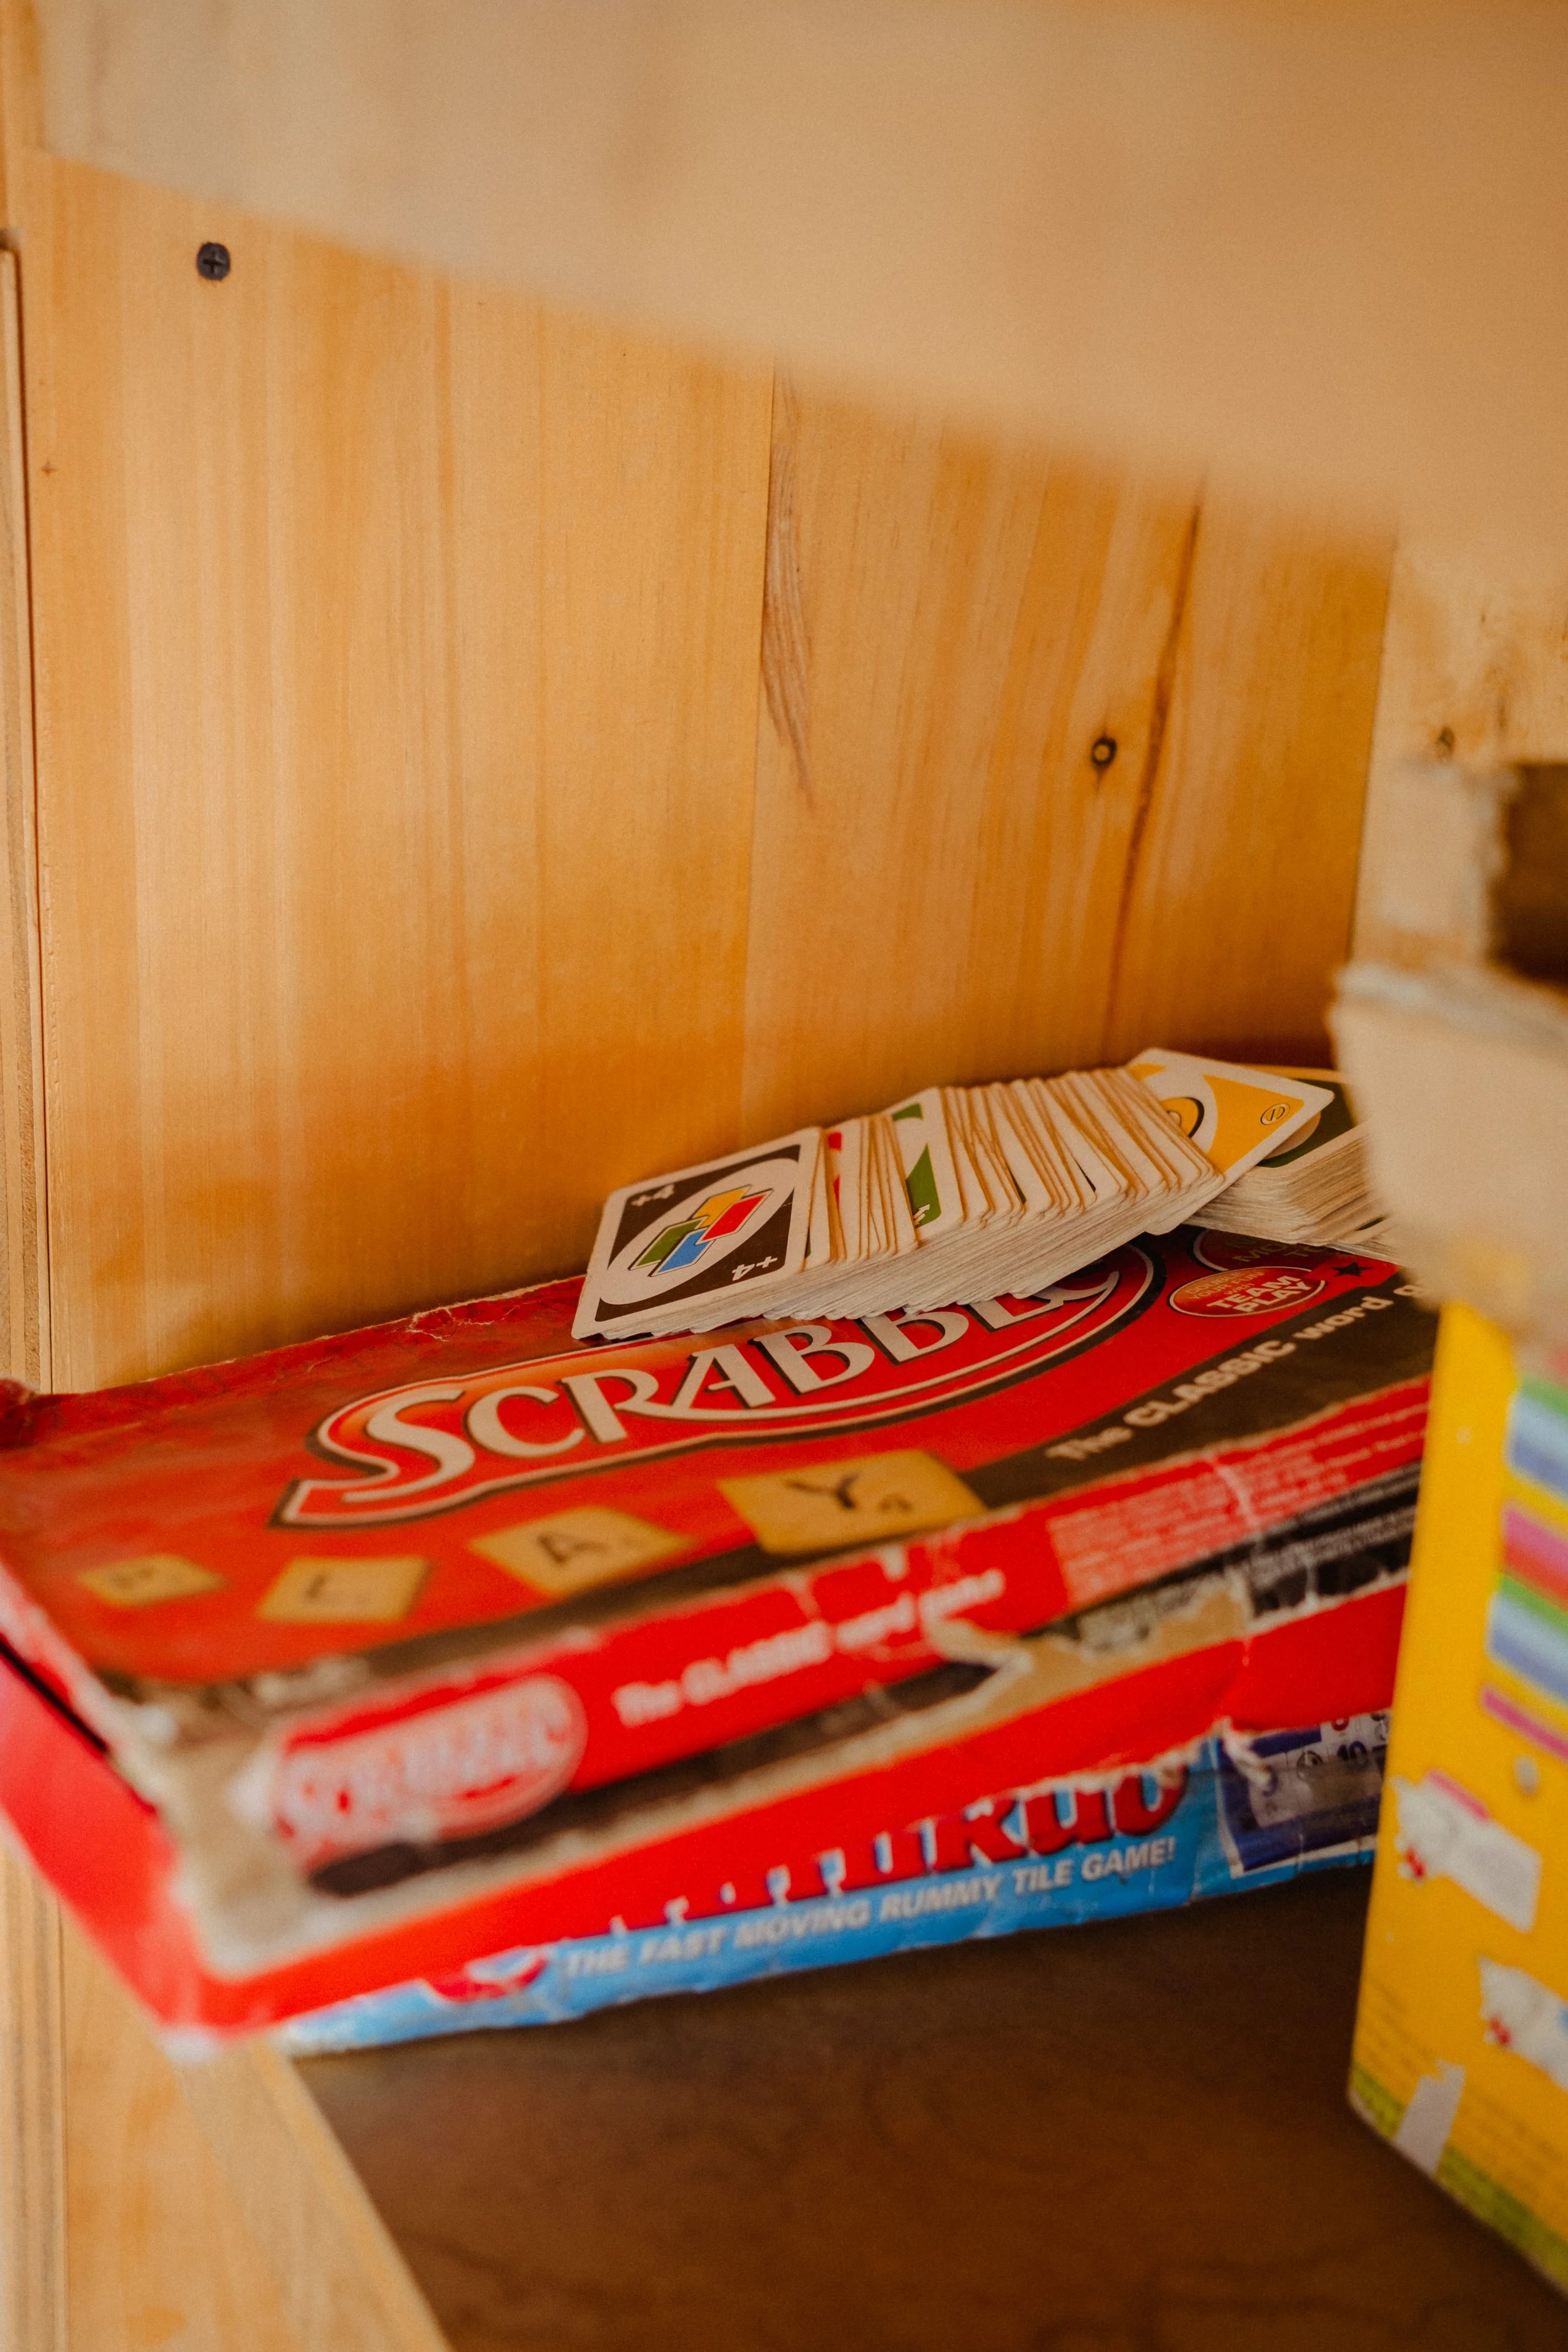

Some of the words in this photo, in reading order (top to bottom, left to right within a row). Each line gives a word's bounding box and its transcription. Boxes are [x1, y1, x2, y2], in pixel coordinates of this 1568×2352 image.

[732, 1256, 778, 1281] +4
[1185, 1271, 1243, 1295] DOUBLE
[1187, 1283, 1232, 1300] YOUR
[1205, 1275, 1302, 1308] TEAM
[1233, 1281, 1311, 1313] PLAY
[1045, 1426, 1134, 1461] The
[1123, 1340, 1296, 1428] CLASSIC
[1293, 1295, 1395, 1341] word
[783, 1470, 862, 1513] Y
[566, 1946, 628, 1978] THE
[638, 1923, 728, 1966] FAST
[733, 1898, 872, 1949] MOVING
[879, 1870, 1003, 1923] RUMMY
[1012, 1858, 1074, 1895] TILE
[1079, 1836, 1177, 1882] GAME!
